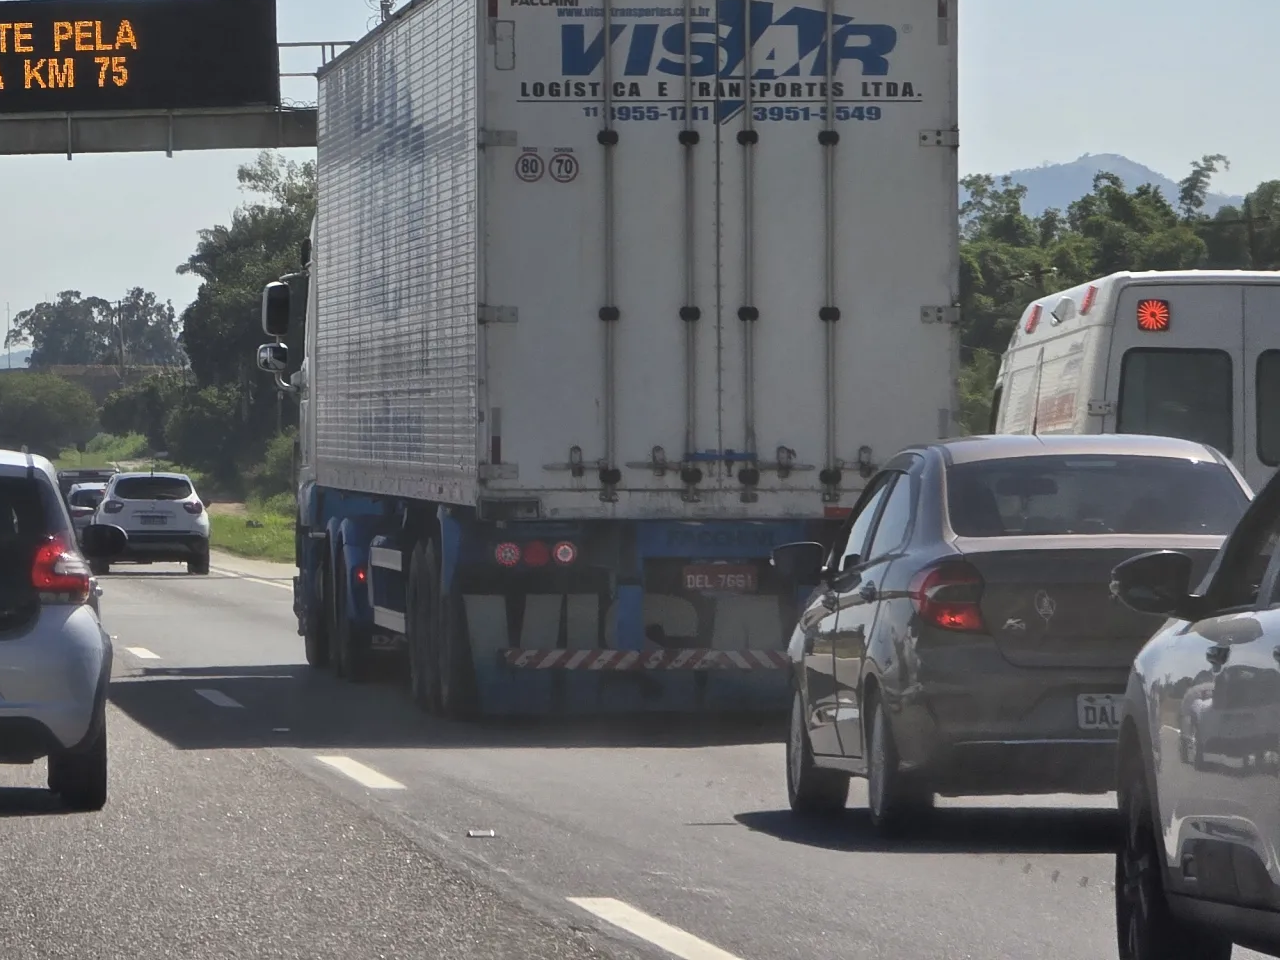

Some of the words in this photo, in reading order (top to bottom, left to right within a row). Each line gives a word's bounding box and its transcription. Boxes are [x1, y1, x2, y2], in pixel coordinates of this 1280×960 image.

[557, 6, 710, 18] www.visatransportes.co.br
[53, 19, 138, 52] PELA
[23, 57, 75, 89] KM
[93, 56, 129, 88] 75
[521, 79, 641, 98] LOGÍSTCA
[657, 81, 668, 98] E
[862, 81, 922, 98] LTDA.
[582, 106, 598, 117] 11
[521, 158, 538, 174] 80
[555, 158, 573, 175] 70
[686, 574, 714, 589] DEL
